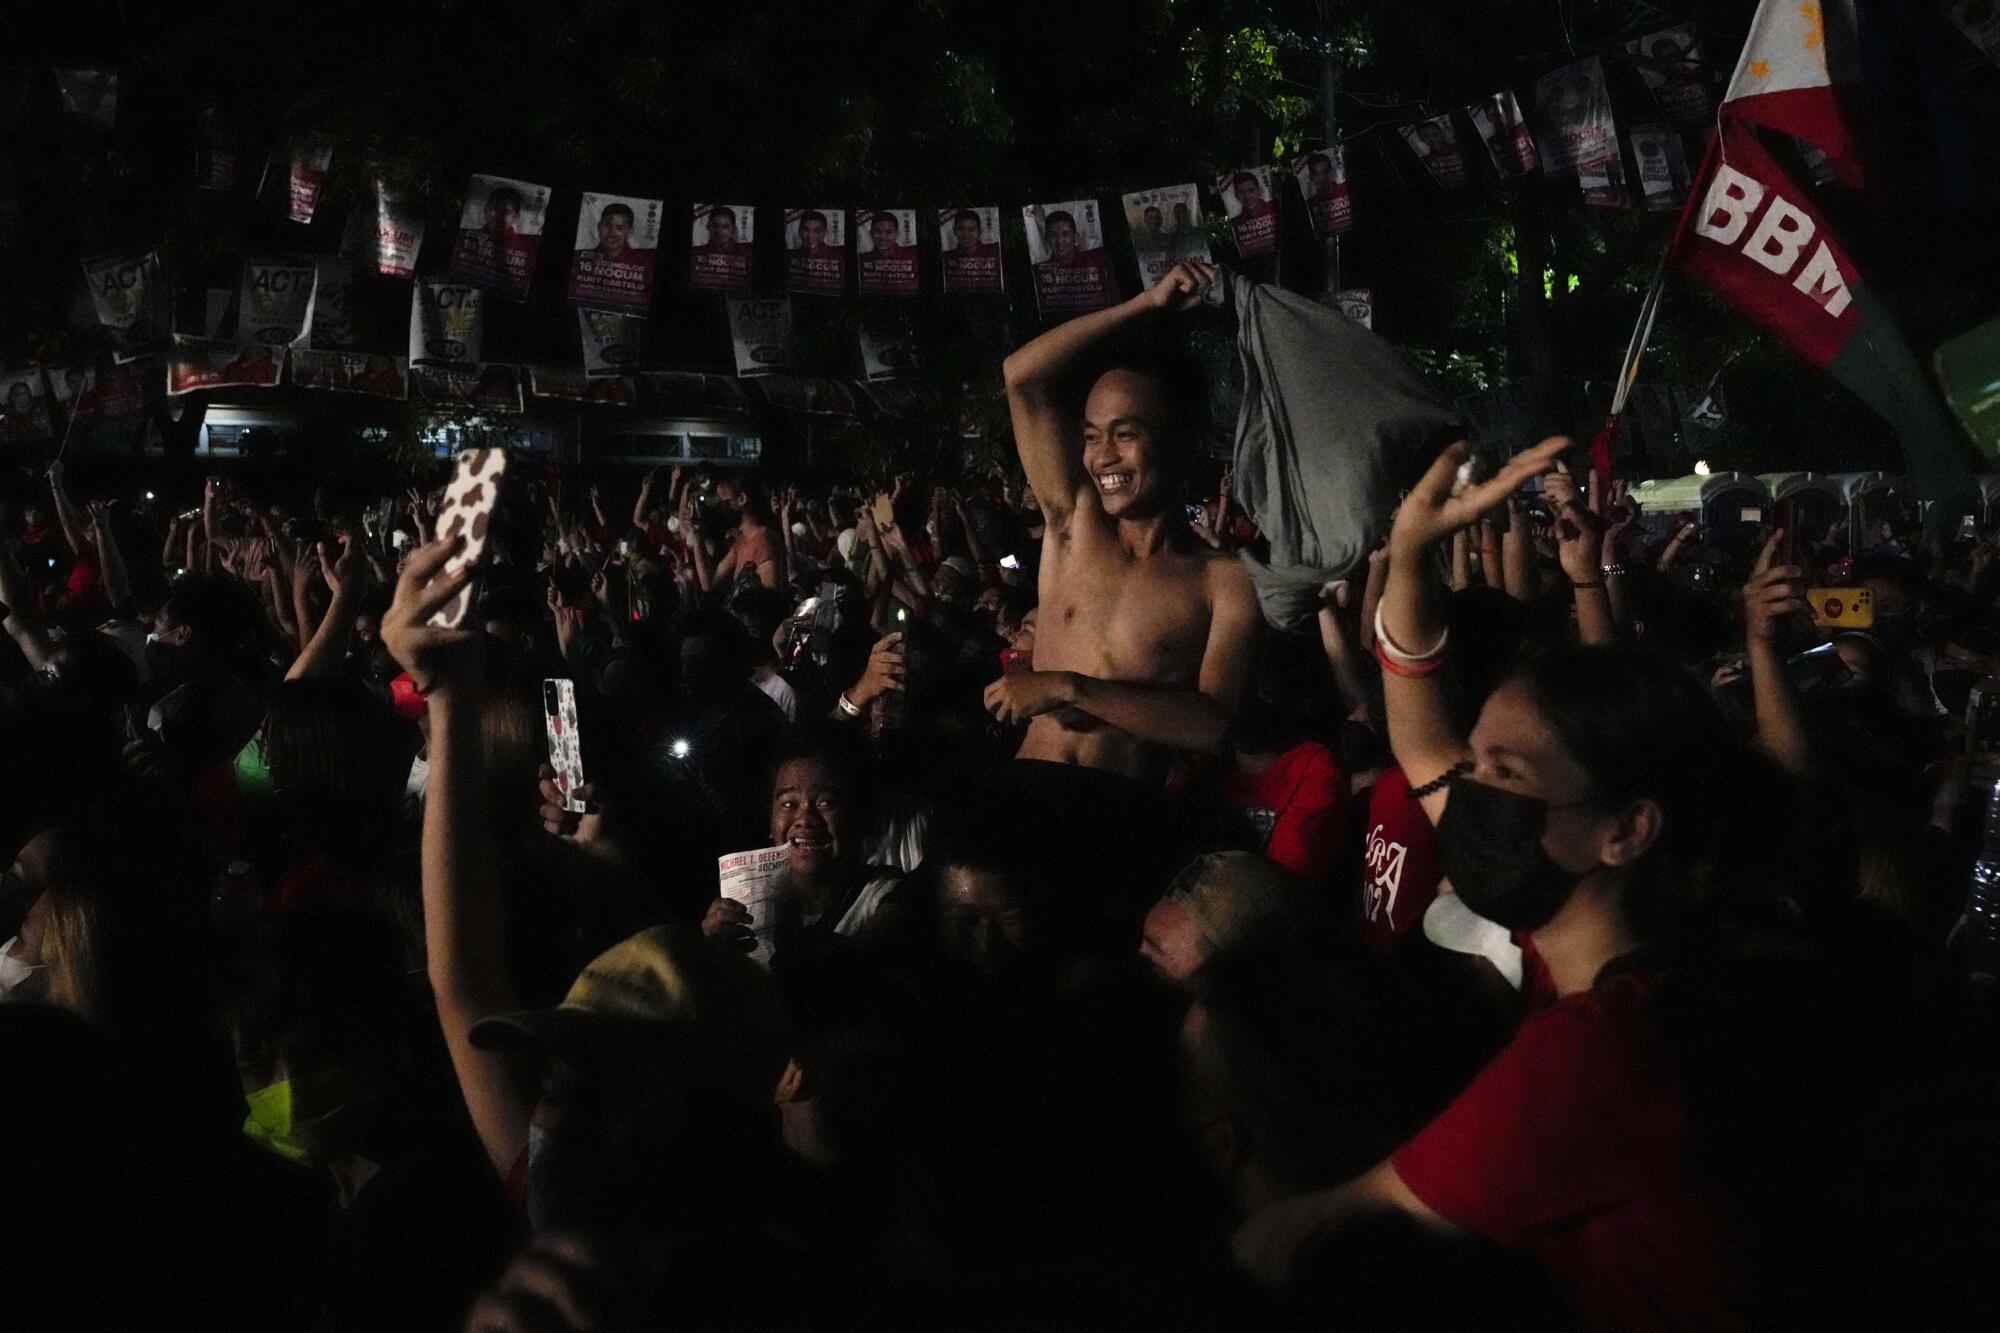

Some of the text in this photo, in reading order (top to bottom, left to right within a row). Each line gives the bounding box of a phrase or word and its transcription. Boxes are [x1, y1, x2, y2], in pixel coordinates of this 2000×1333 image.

[1694, 163, 1852, 318] BBM
[254, 269, 306, 293] ACT
[580, 261, 643, 282] 16 NOCUM
[603, 279, 645, 292] CASTELO
